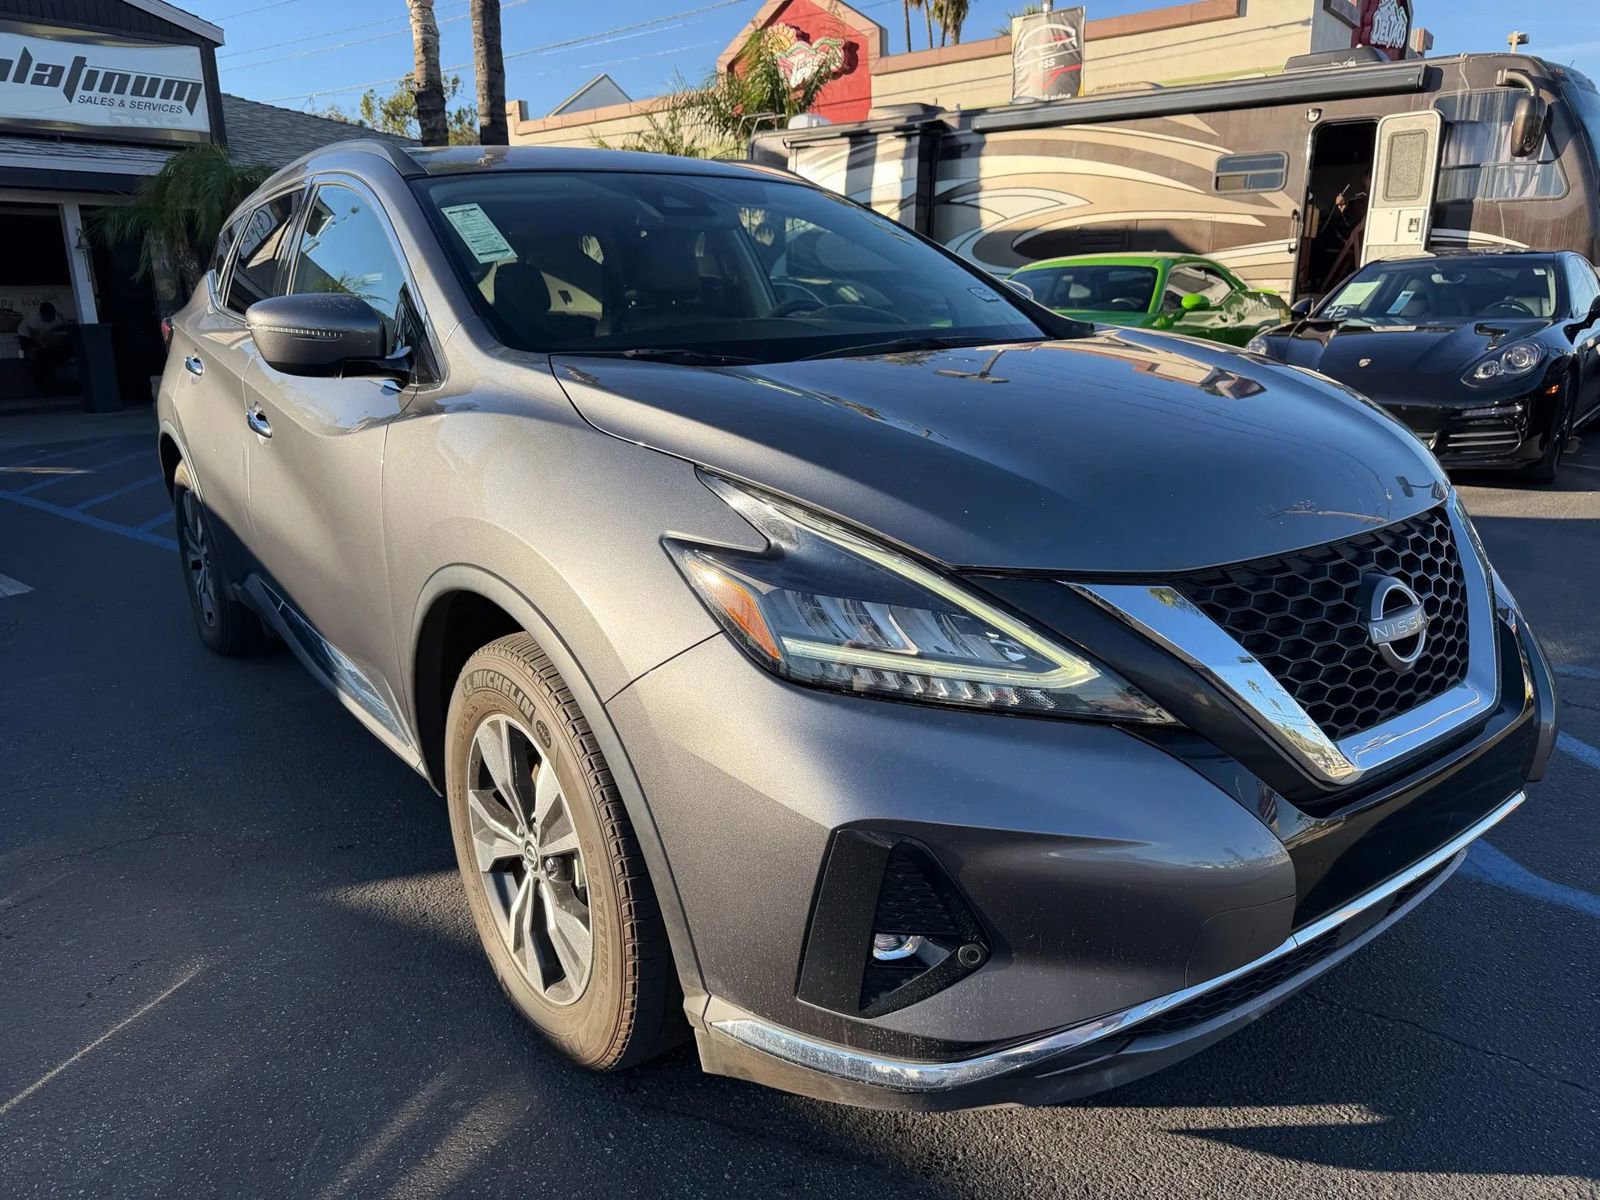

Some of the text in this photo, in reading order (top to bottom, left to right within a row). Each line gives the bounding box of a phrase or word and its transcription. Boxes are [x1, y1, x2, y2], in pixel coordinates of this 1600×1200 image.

[78, 95, 184, 114] SALES & SERVICES
[473, 671, 536, 724] MICHELIN
